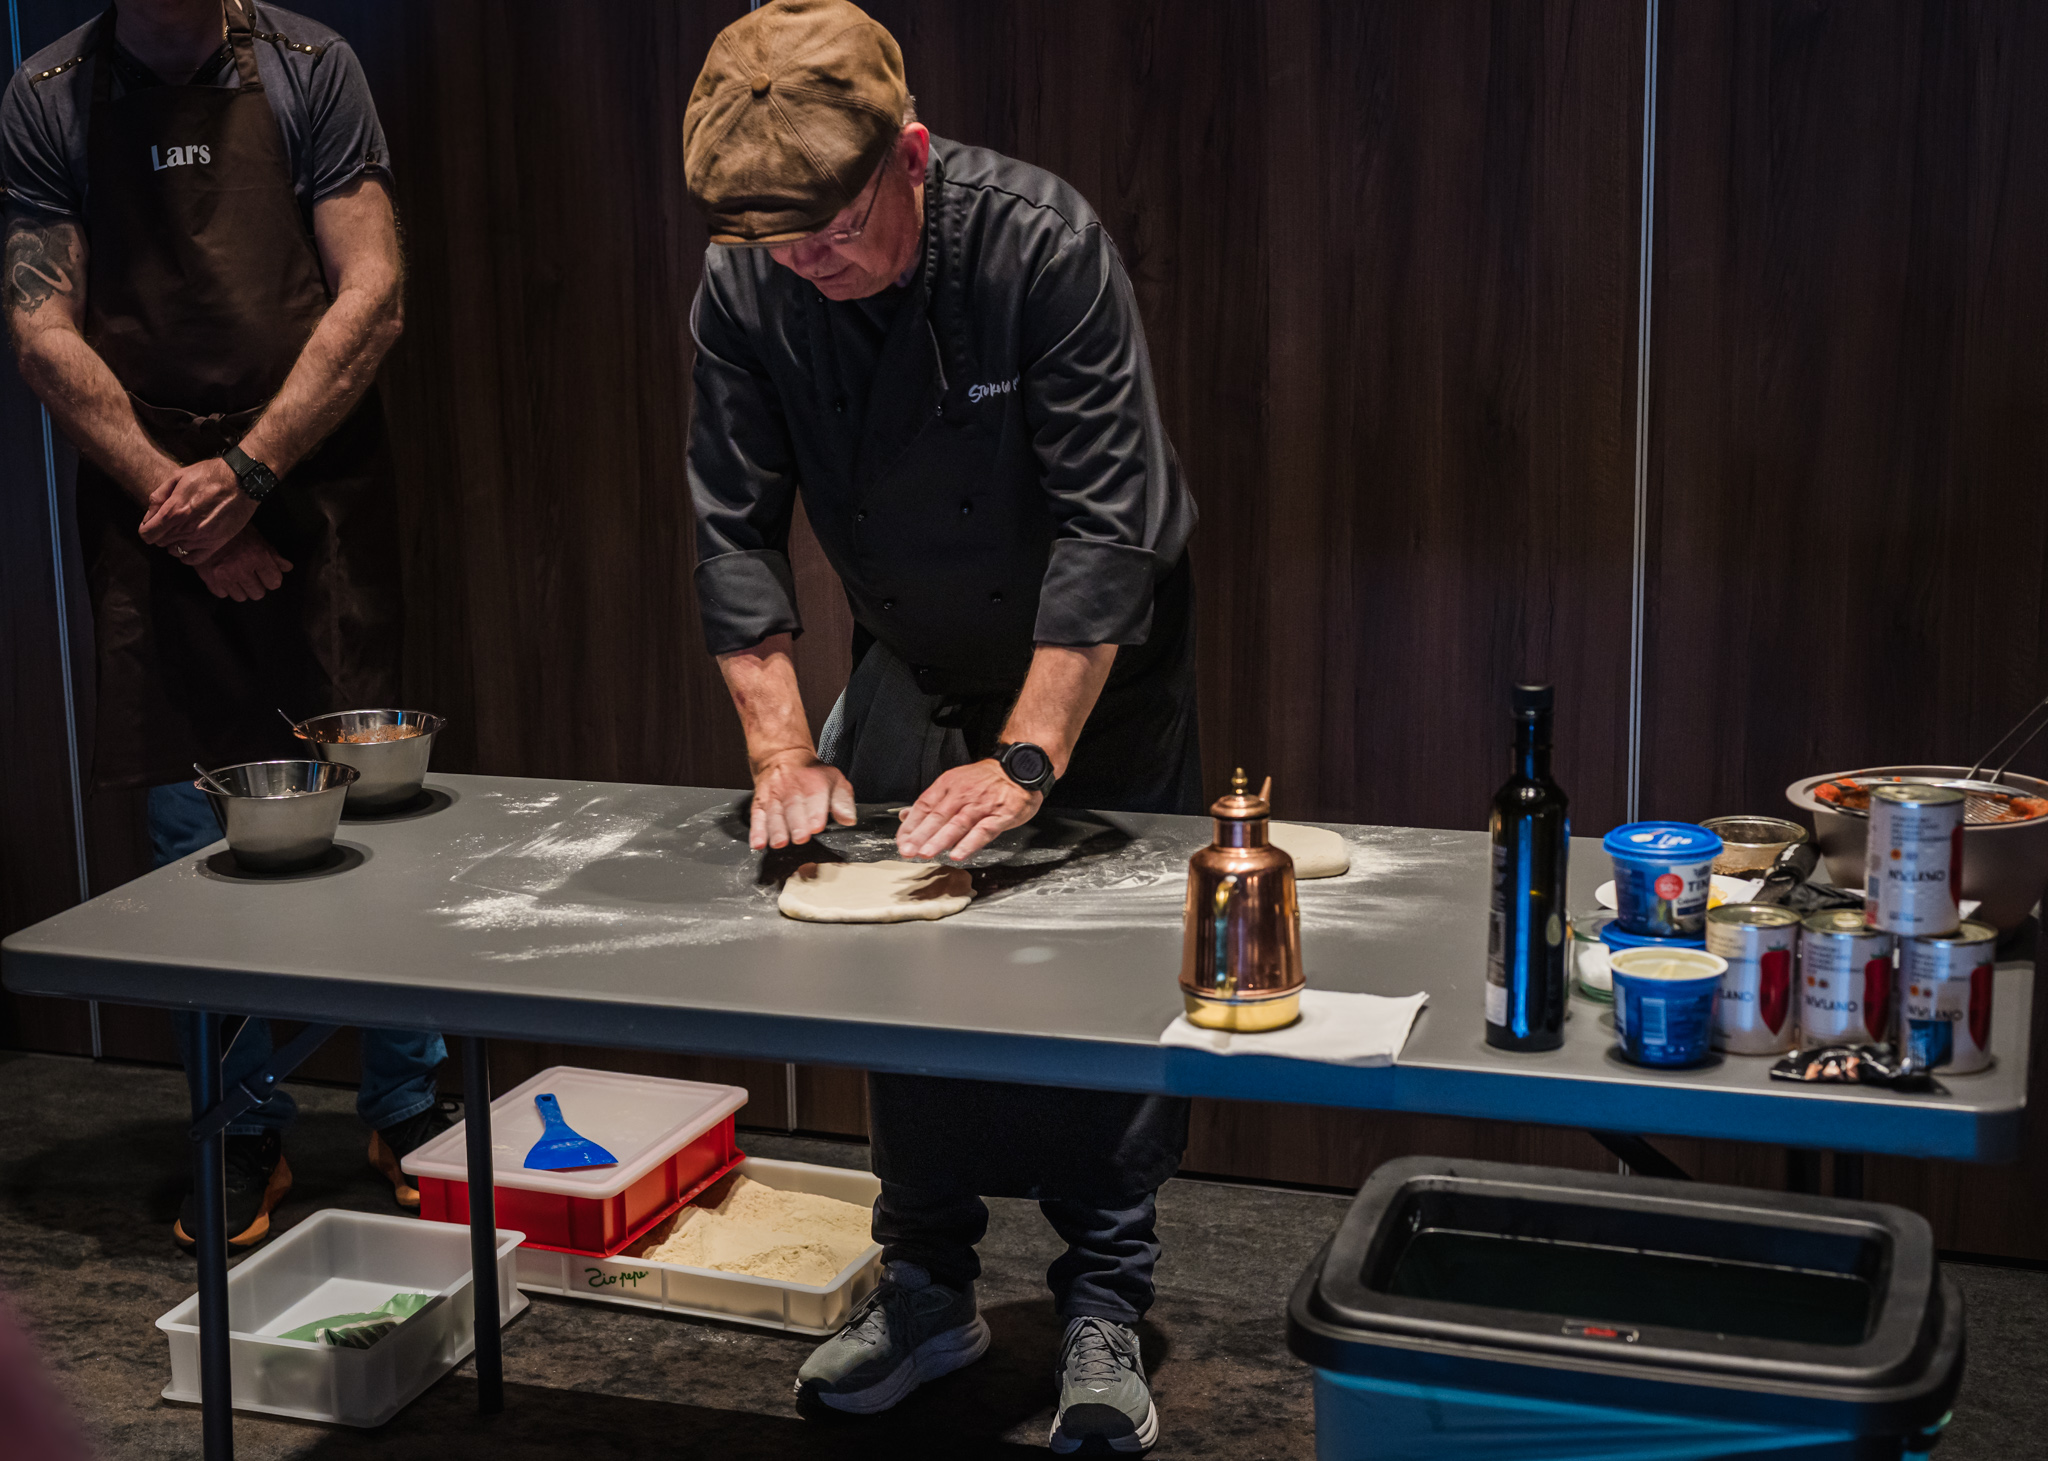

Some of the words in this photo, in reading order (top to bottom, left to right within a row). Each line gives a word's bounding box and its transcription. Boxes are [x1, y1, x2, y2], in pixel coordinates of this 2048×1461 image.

[151, 145, 211, 171] Lars
[585, 1268, 617, 1288] Zio
[619, 1270, 649, 1288] pepe
